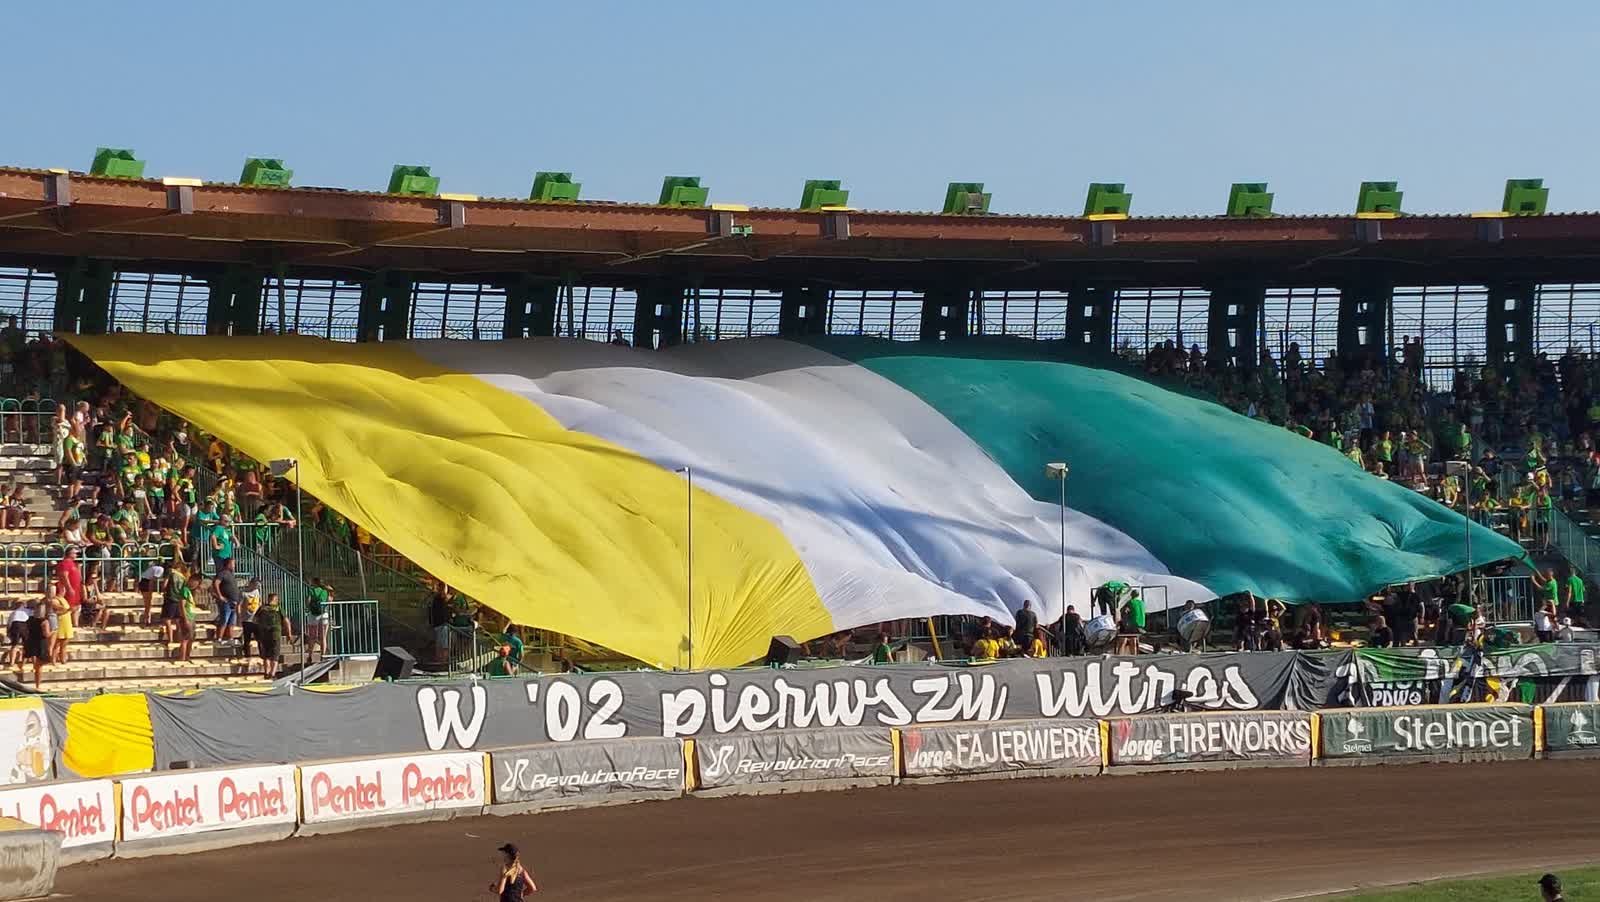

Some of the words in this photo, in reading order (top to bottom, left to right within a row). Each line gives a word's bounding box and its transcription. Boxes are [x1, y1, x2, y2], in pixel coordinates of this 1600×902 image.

[417, 686, 486, 750] W
[527, 680, 627, 742] '02
[1036, 662, 1258, 717] ultras
[956, 727, 1101, 766] FAJERWERKI
[1119, 737, 1163, 761] Jorge
[1169, 719, 1311, 754] FIREWORKS
[1394, 712, 1523, 751] Stelmet
[310, 770, 386, 818] Pentel
[402, 763, 477, 805] Pentel
[530, 766, 680, 790] RevolutionRace
[40, 792, 106, 837] Pentel
[131, 785, 204, 832] Pentel
[218, 777, 288, 822] Pentel
